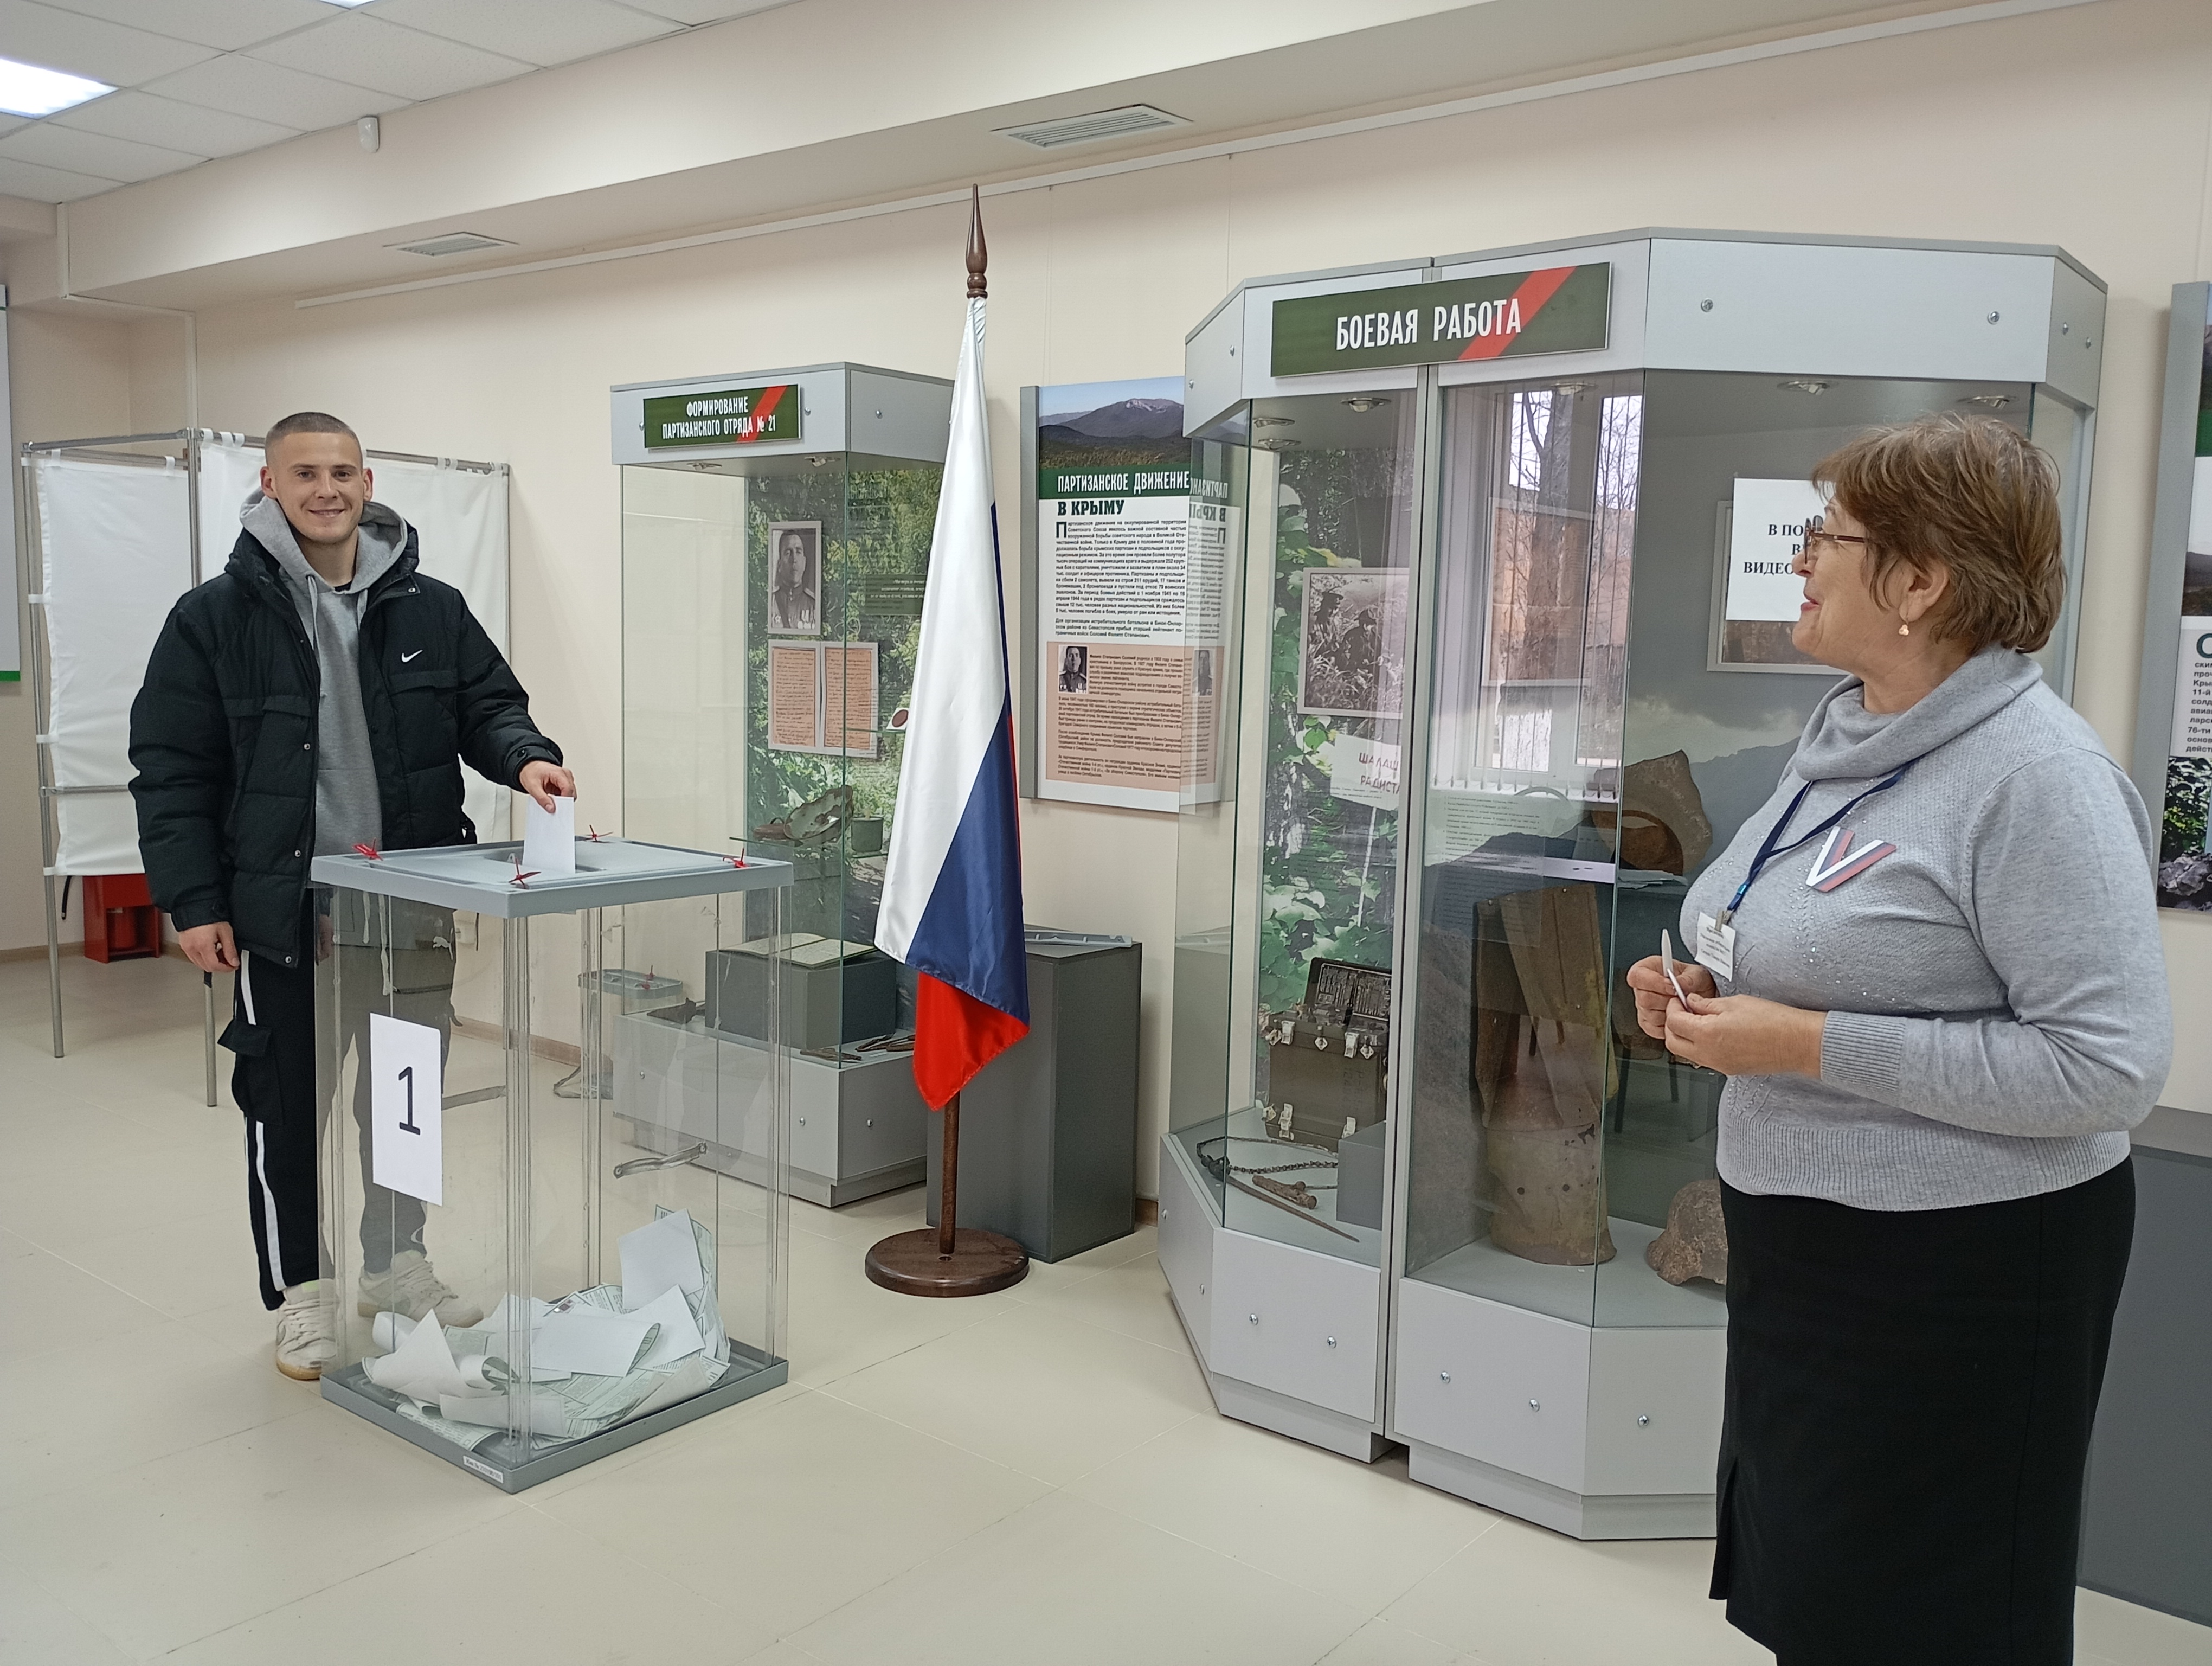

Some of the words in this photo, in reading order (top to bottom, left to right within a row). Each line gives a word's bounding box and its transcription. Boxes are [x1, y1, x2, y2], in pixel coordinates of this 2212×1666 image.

[1336, 308, 1418, 351] БОЕВАЯ
[1433, 298, 1521, 342] РАБОТА
[686, 396, 748, 418] ФОРМИРОВАНИЕ
[662, 419, 721, 439] ПАРТИЗАНСКОГО
[724, 416, 753, 438] ОТРЯДА
[757, 416, 764, 433] №
[768, 415, 776, 431] 21
[1058, 473, 1129, 492] ПАРТИЗАНСКОЕ
[1133, 471, 1189, 495] ДВИЖЕНИЕ
[1058, 502, 1066, 516] В
[1071, 500, 1124, 515] КРЫМУ
[1768, 524, 1777, 536] В
[1782, 524, 1804, 536] ПО
[1744, 562, 1794, 576] ВИДЕО
[1359, 752, 1399, 771] ШАЛАШ
[398, 1066, 421, 1136] 1
